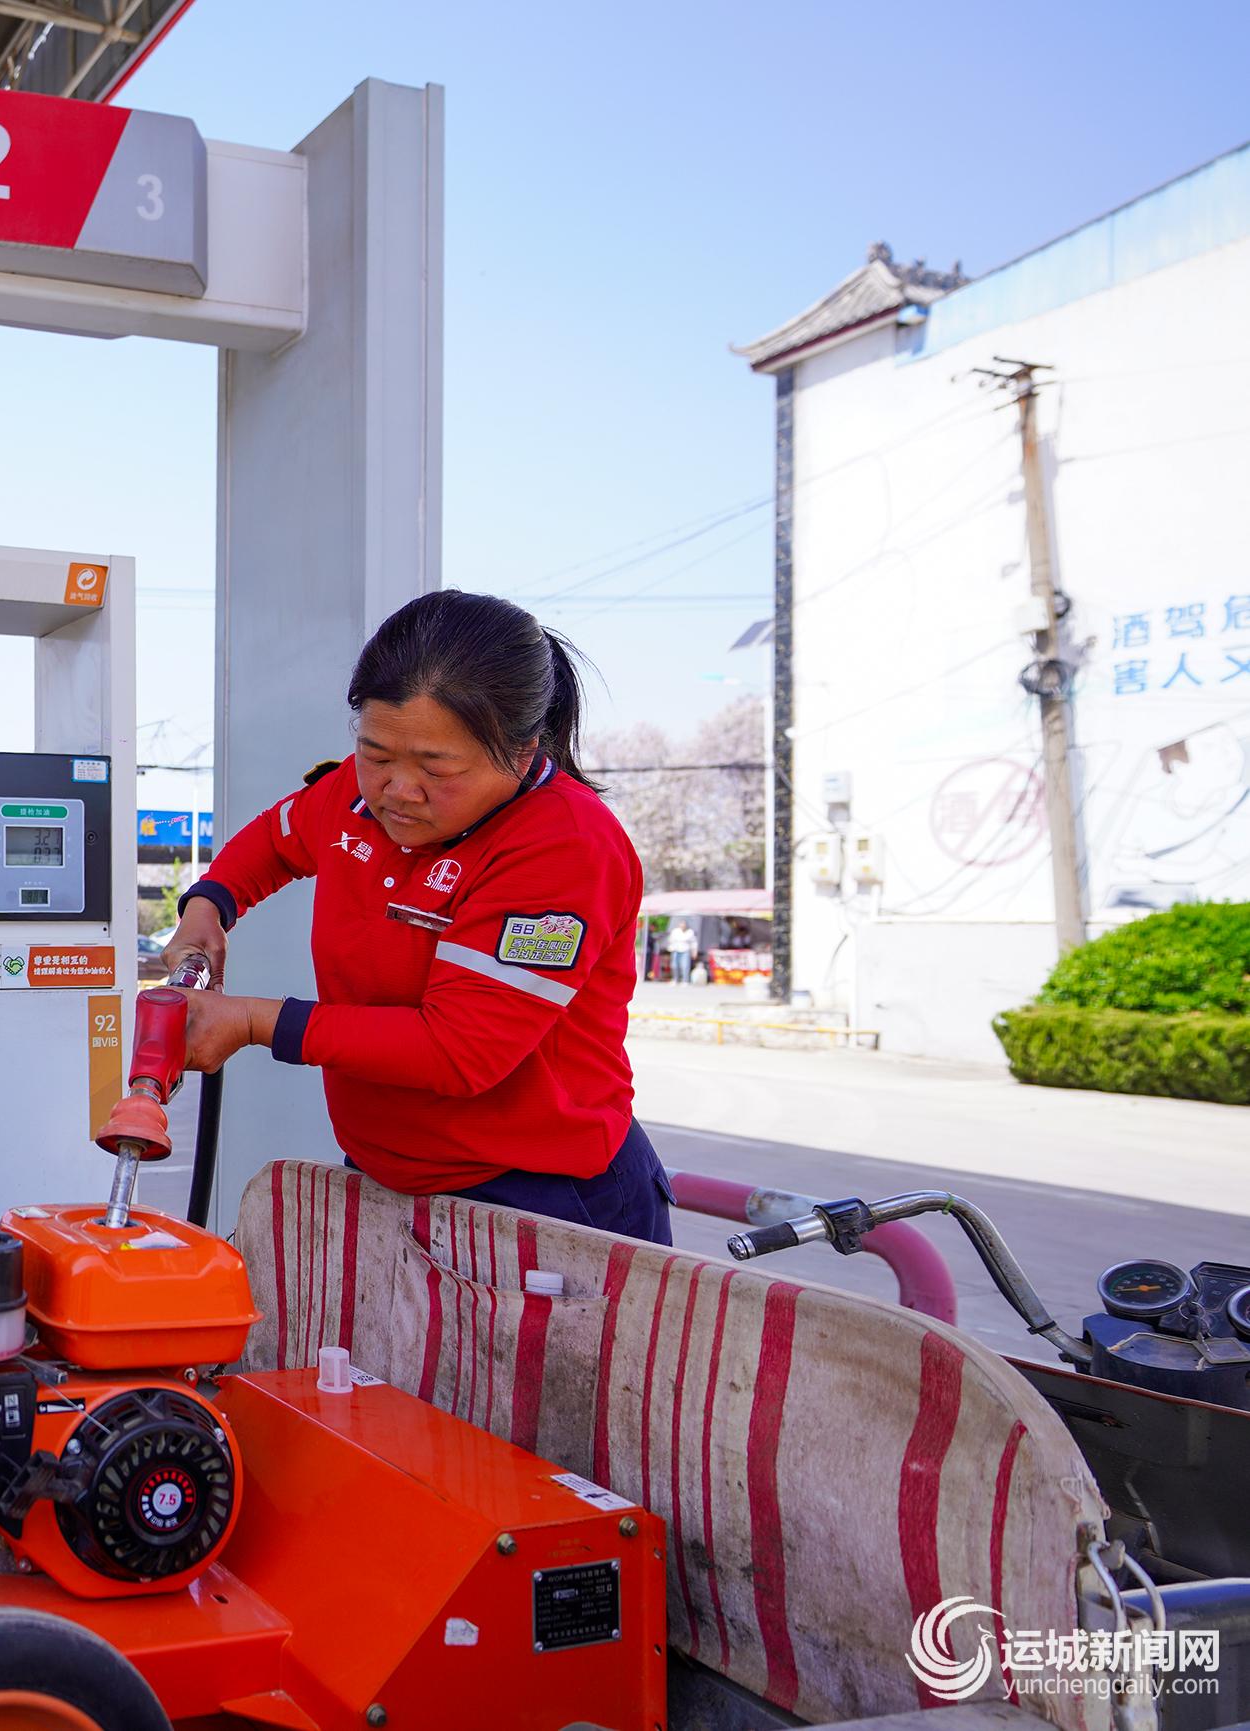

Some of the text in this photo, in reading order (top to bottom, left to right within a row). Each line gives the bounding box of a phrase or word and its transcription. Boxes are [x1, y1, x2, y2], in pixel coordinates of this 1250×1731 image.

[135, 174, 165, 221] 3
[94, 1014, 116, 1032] 92
[159, 1493, 177, 1506] 7.5
